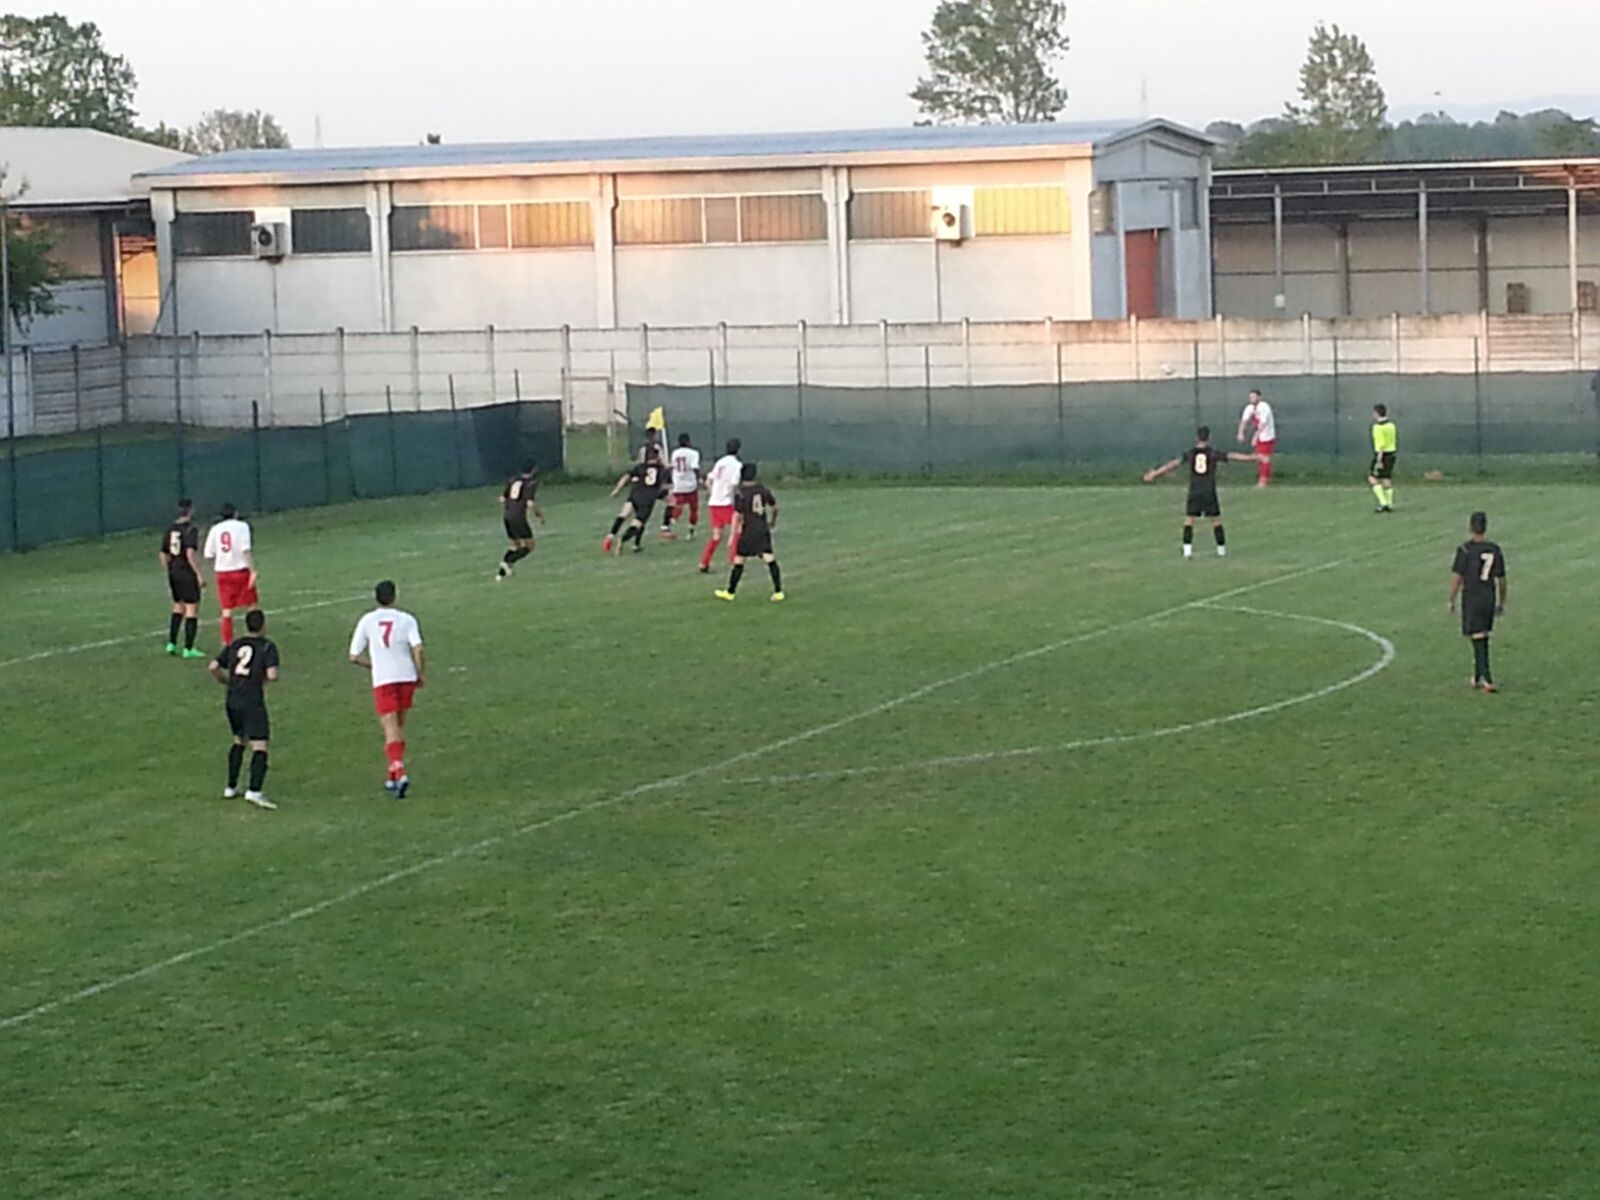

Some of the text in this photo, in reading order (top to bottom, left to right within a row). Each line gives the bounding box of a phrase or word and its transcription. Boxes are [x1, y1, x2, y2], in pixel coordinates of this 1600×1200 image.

[1194, 453, 1207, 474] 8
[644, 467, 658, 486] 3
[220, 530, 232, 553] 9
[1480, 553, 1495, 581] 7
[378, 621, 393, 648] 7
[234, 645, 254, 676] 2
